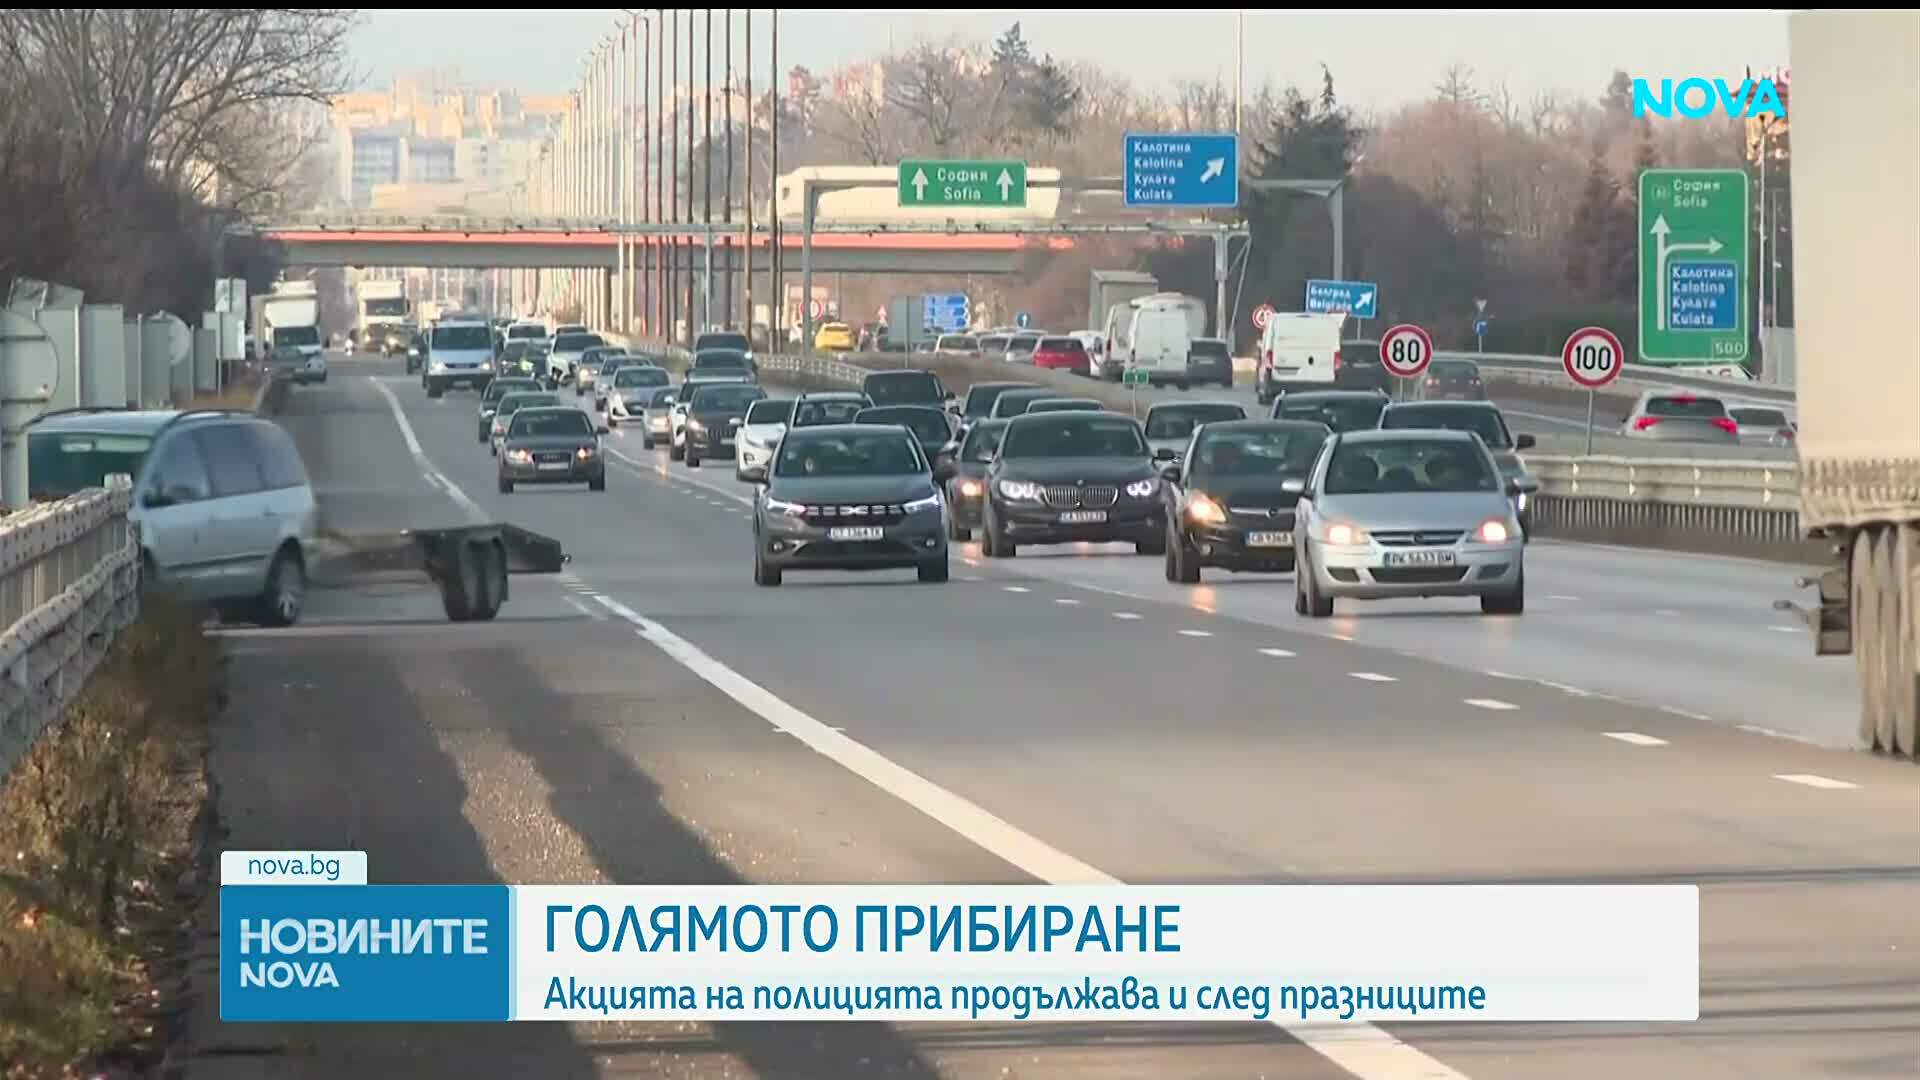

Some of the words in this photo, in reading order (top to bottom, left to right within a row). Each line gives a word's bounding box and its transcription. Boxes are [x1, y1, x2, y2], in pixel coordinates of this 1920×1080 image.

[1134, 141, 1191, 153] Калотина
[1134, 156, 1184, 169] Kalotina
[937, 167, 988, 181] София
[1134, 174, 1176, 187] Кулата
[1673, 178, 1721, 192] София
[944, 186, 981, 200] Sofia
[1134, 188, 1173, 201] Kulata
[1673, 194, 1708, 208] Sofia
[1672, 265, 1734, 279] Калотина
[1672, 280, 1726, 294] Kalotina
[1672, 295, 1717, 311] Кулата
[1672, 312, 1714, 325] Kulata
[1392, 339, 1420, 363] 80
[1575, 346, 1610, 370] 100
